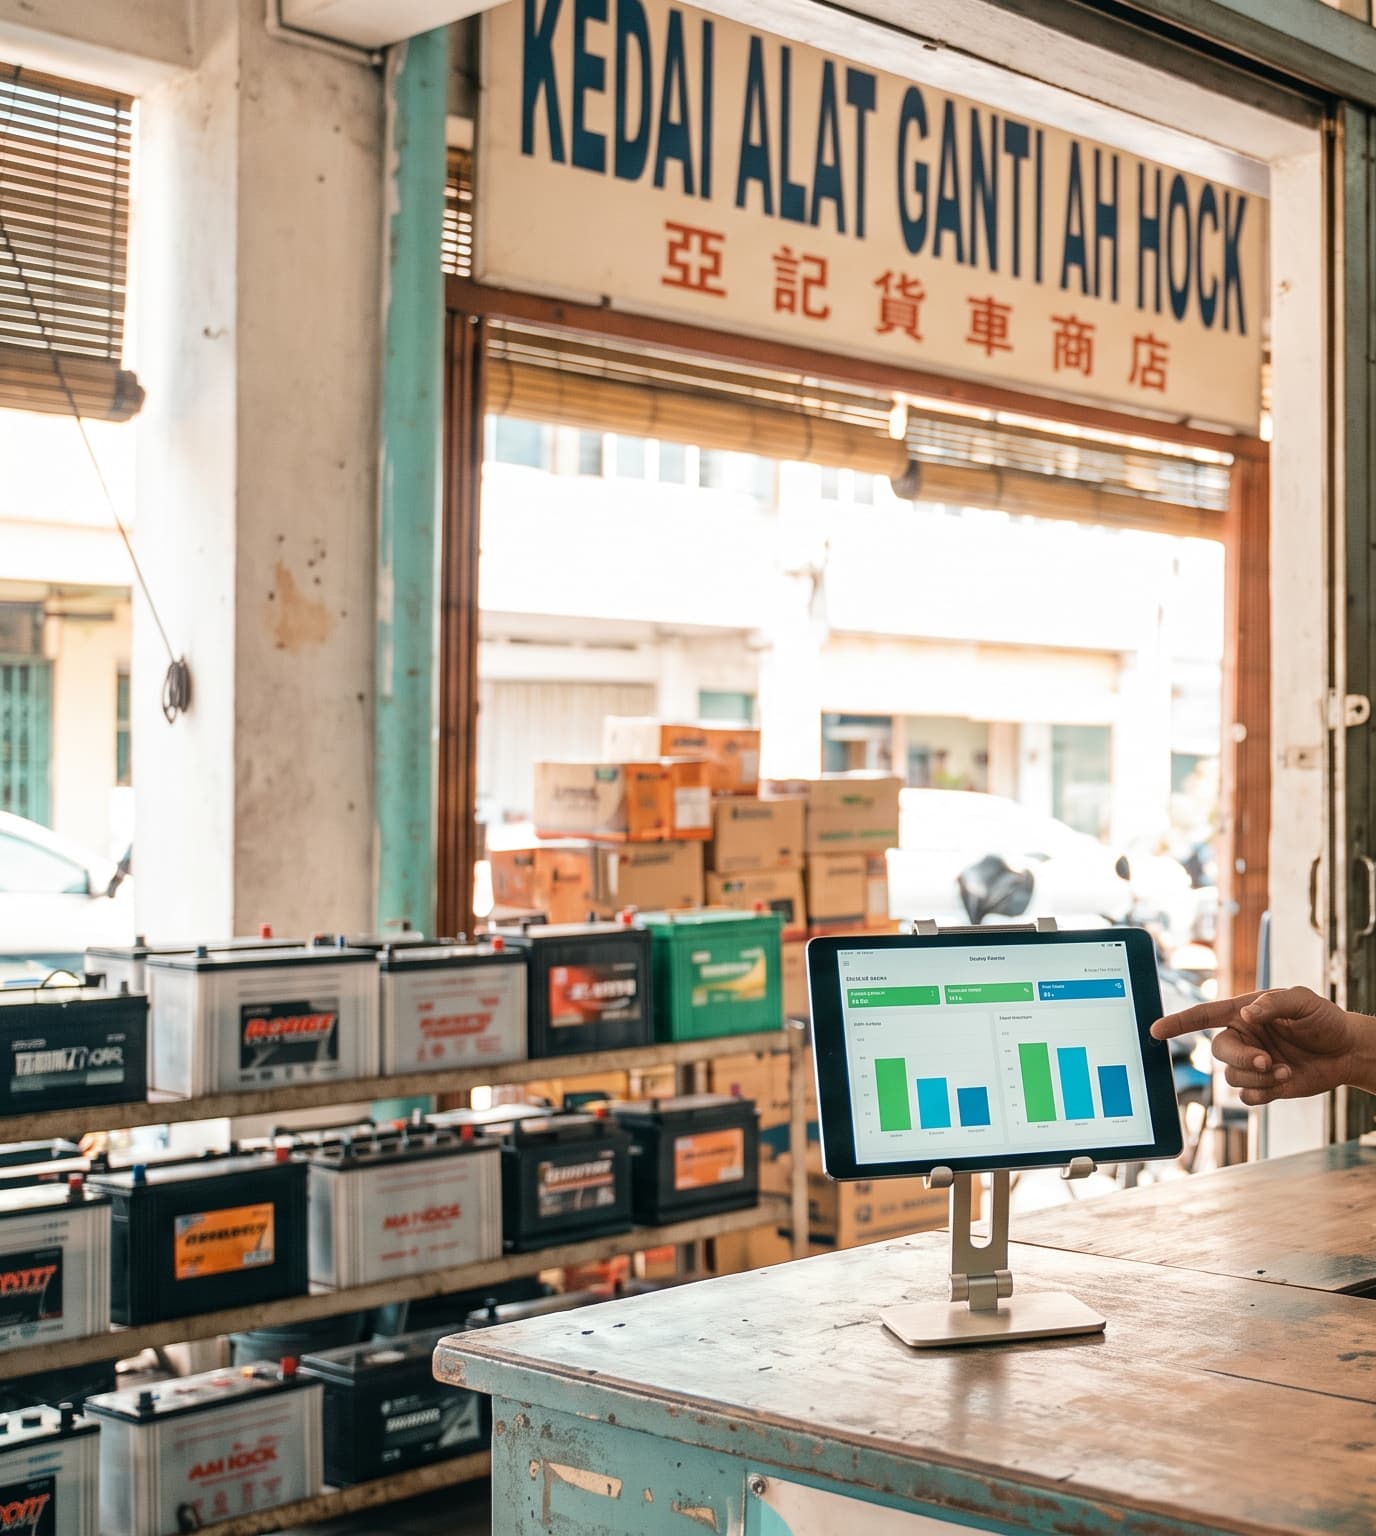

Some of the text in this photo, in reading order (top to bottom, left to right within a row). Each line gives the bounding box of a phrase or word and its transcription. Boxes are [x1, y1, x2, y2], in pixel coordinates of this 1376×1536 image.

[521, 0, 1247, 337] KEDAI ALAT GANTI AH HOCK
[661, 221, 1170, 393] 亞記貨車商店
